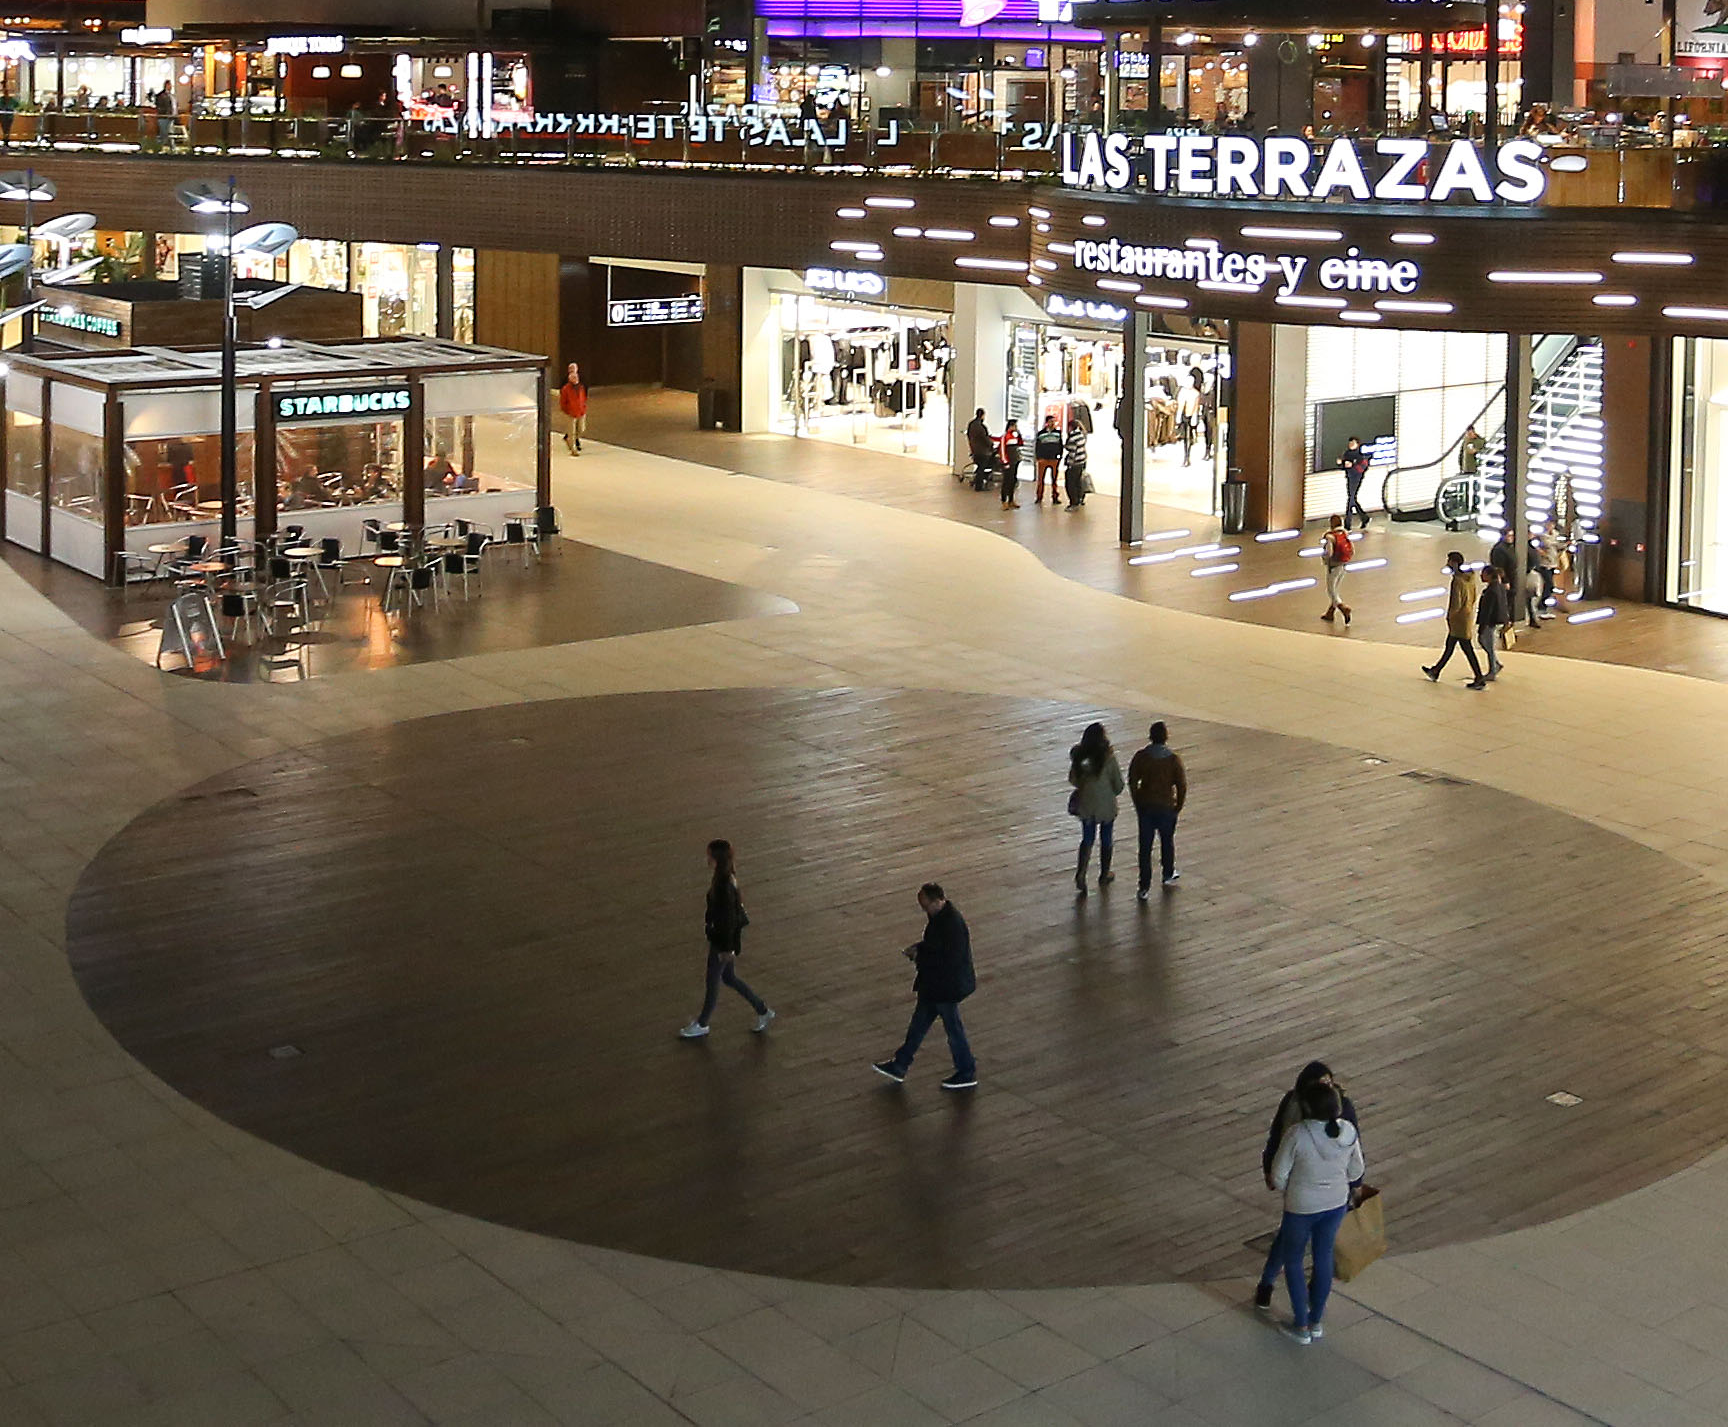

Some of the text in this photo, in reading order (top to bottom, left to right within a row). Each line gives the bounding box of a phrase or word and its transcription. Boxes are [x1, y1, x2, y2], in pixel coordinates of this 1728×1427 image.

[1062, 133, 1131, 189] LAS
[1144, 134, 1546, 203] TERRAZAS
[1073, 237, 1266, 286] restaurantes
[1276, 255, 1305, 296] y
[279, 390, 411, 417] STARBUCKS
